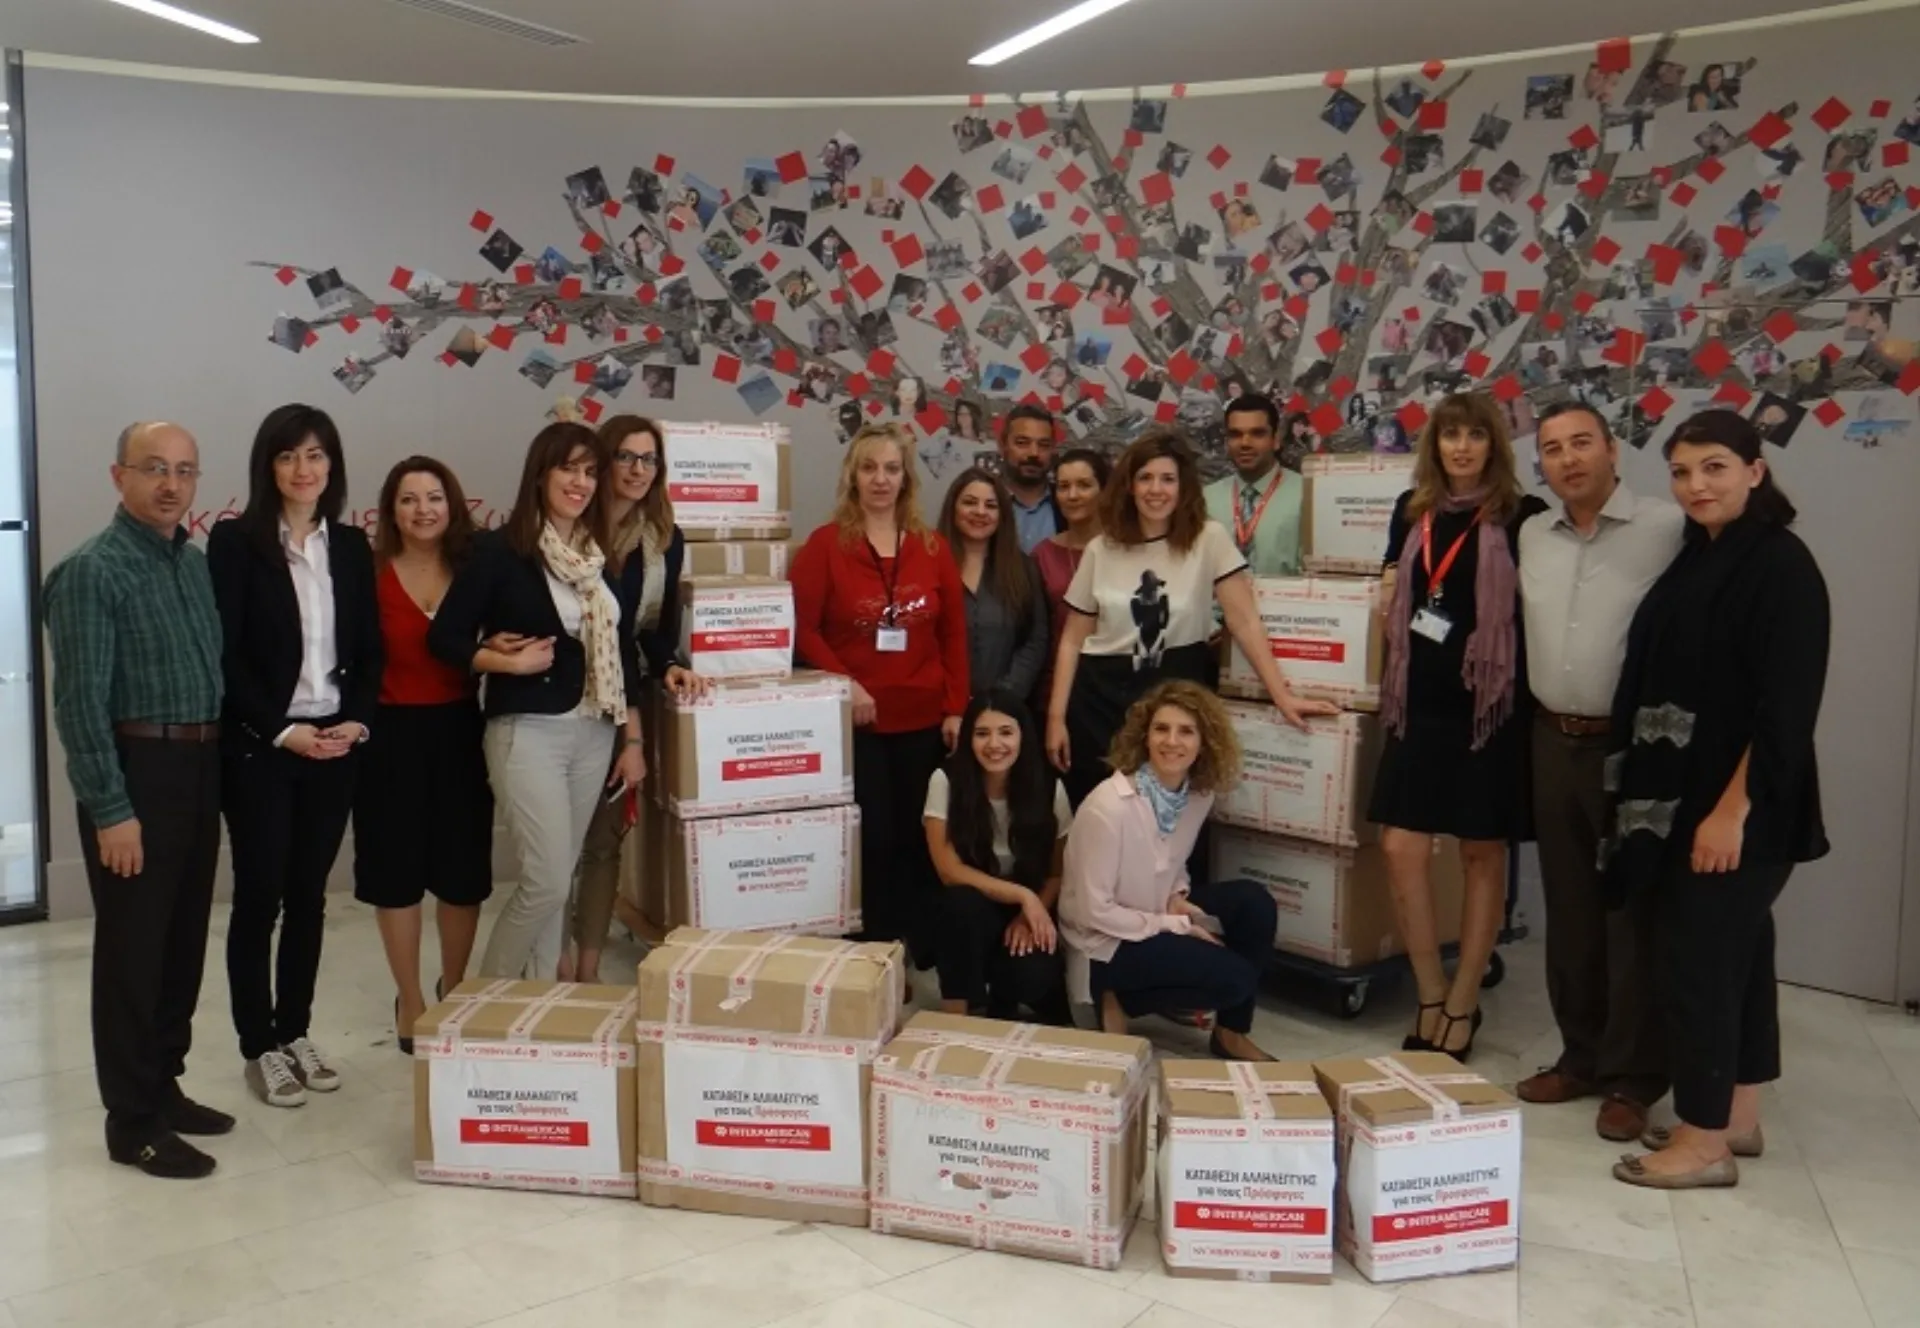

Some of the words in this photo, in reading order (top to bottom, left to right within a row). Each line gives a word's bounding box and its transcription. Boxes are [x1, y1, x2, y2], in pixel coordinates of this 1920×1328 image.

[491, 1124, 571, 1135] INTERAMERICAN
[729, 1126, 812, 1139] INTERAMERICAN
[928, 1134, 978, 1151] ΚΑΤΑΘΕΣΗ
[1184, 1168, 1240, 1183] ΚΑΤΑΘΕΣΗ
[1240, 1170, 1318, 1186] ΑΛΛΗΛΕΓΓΥΗΣ
[1381, 1176, 1432, 1193] ΚΑΤΑΘΕΣΗ
[1197, 1186, 1216, 1197] για
[1216, 1186, 1242, 1199] τους
[1211, 1207, 1305, 1222] INTERAMERICAN
[1408, 1207, 1490, 1229] INTERAMERICAN
